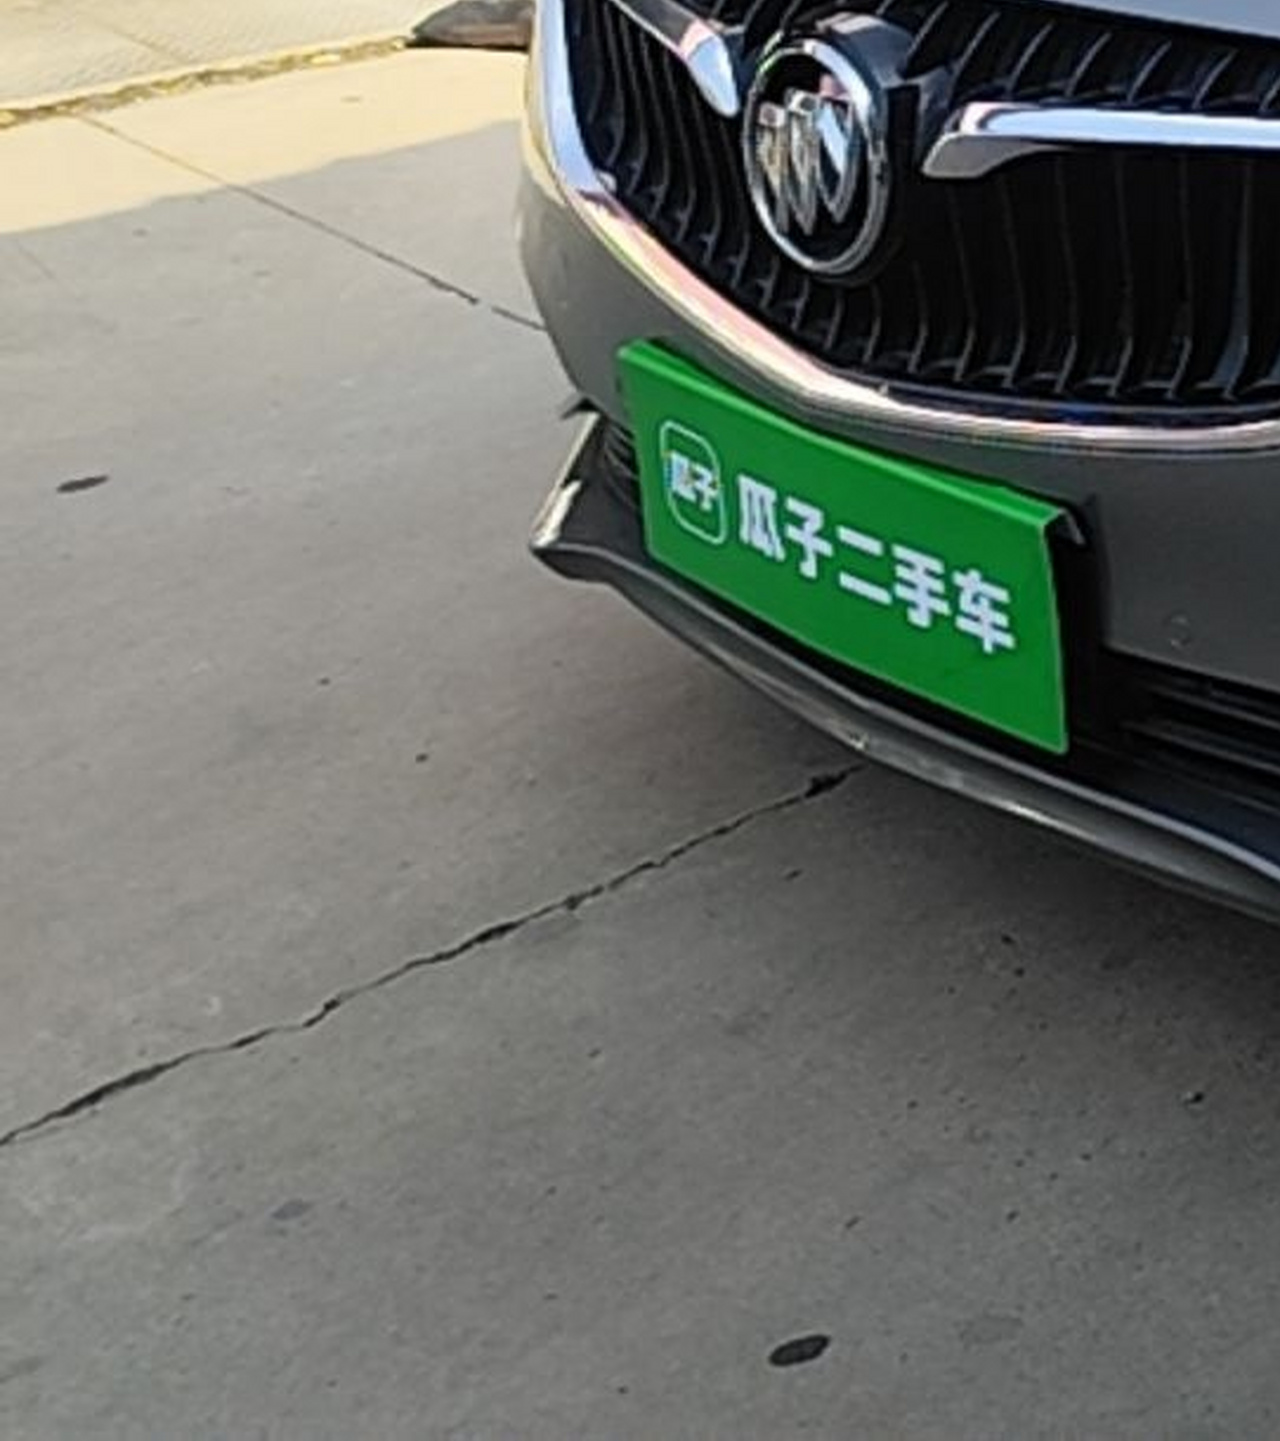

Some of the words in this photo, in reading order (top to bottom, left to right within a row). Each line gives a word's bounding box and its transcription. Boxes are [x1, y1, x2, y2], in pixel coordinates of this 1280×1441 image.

[736, 472, 1017, 656] 瓜子二手车
